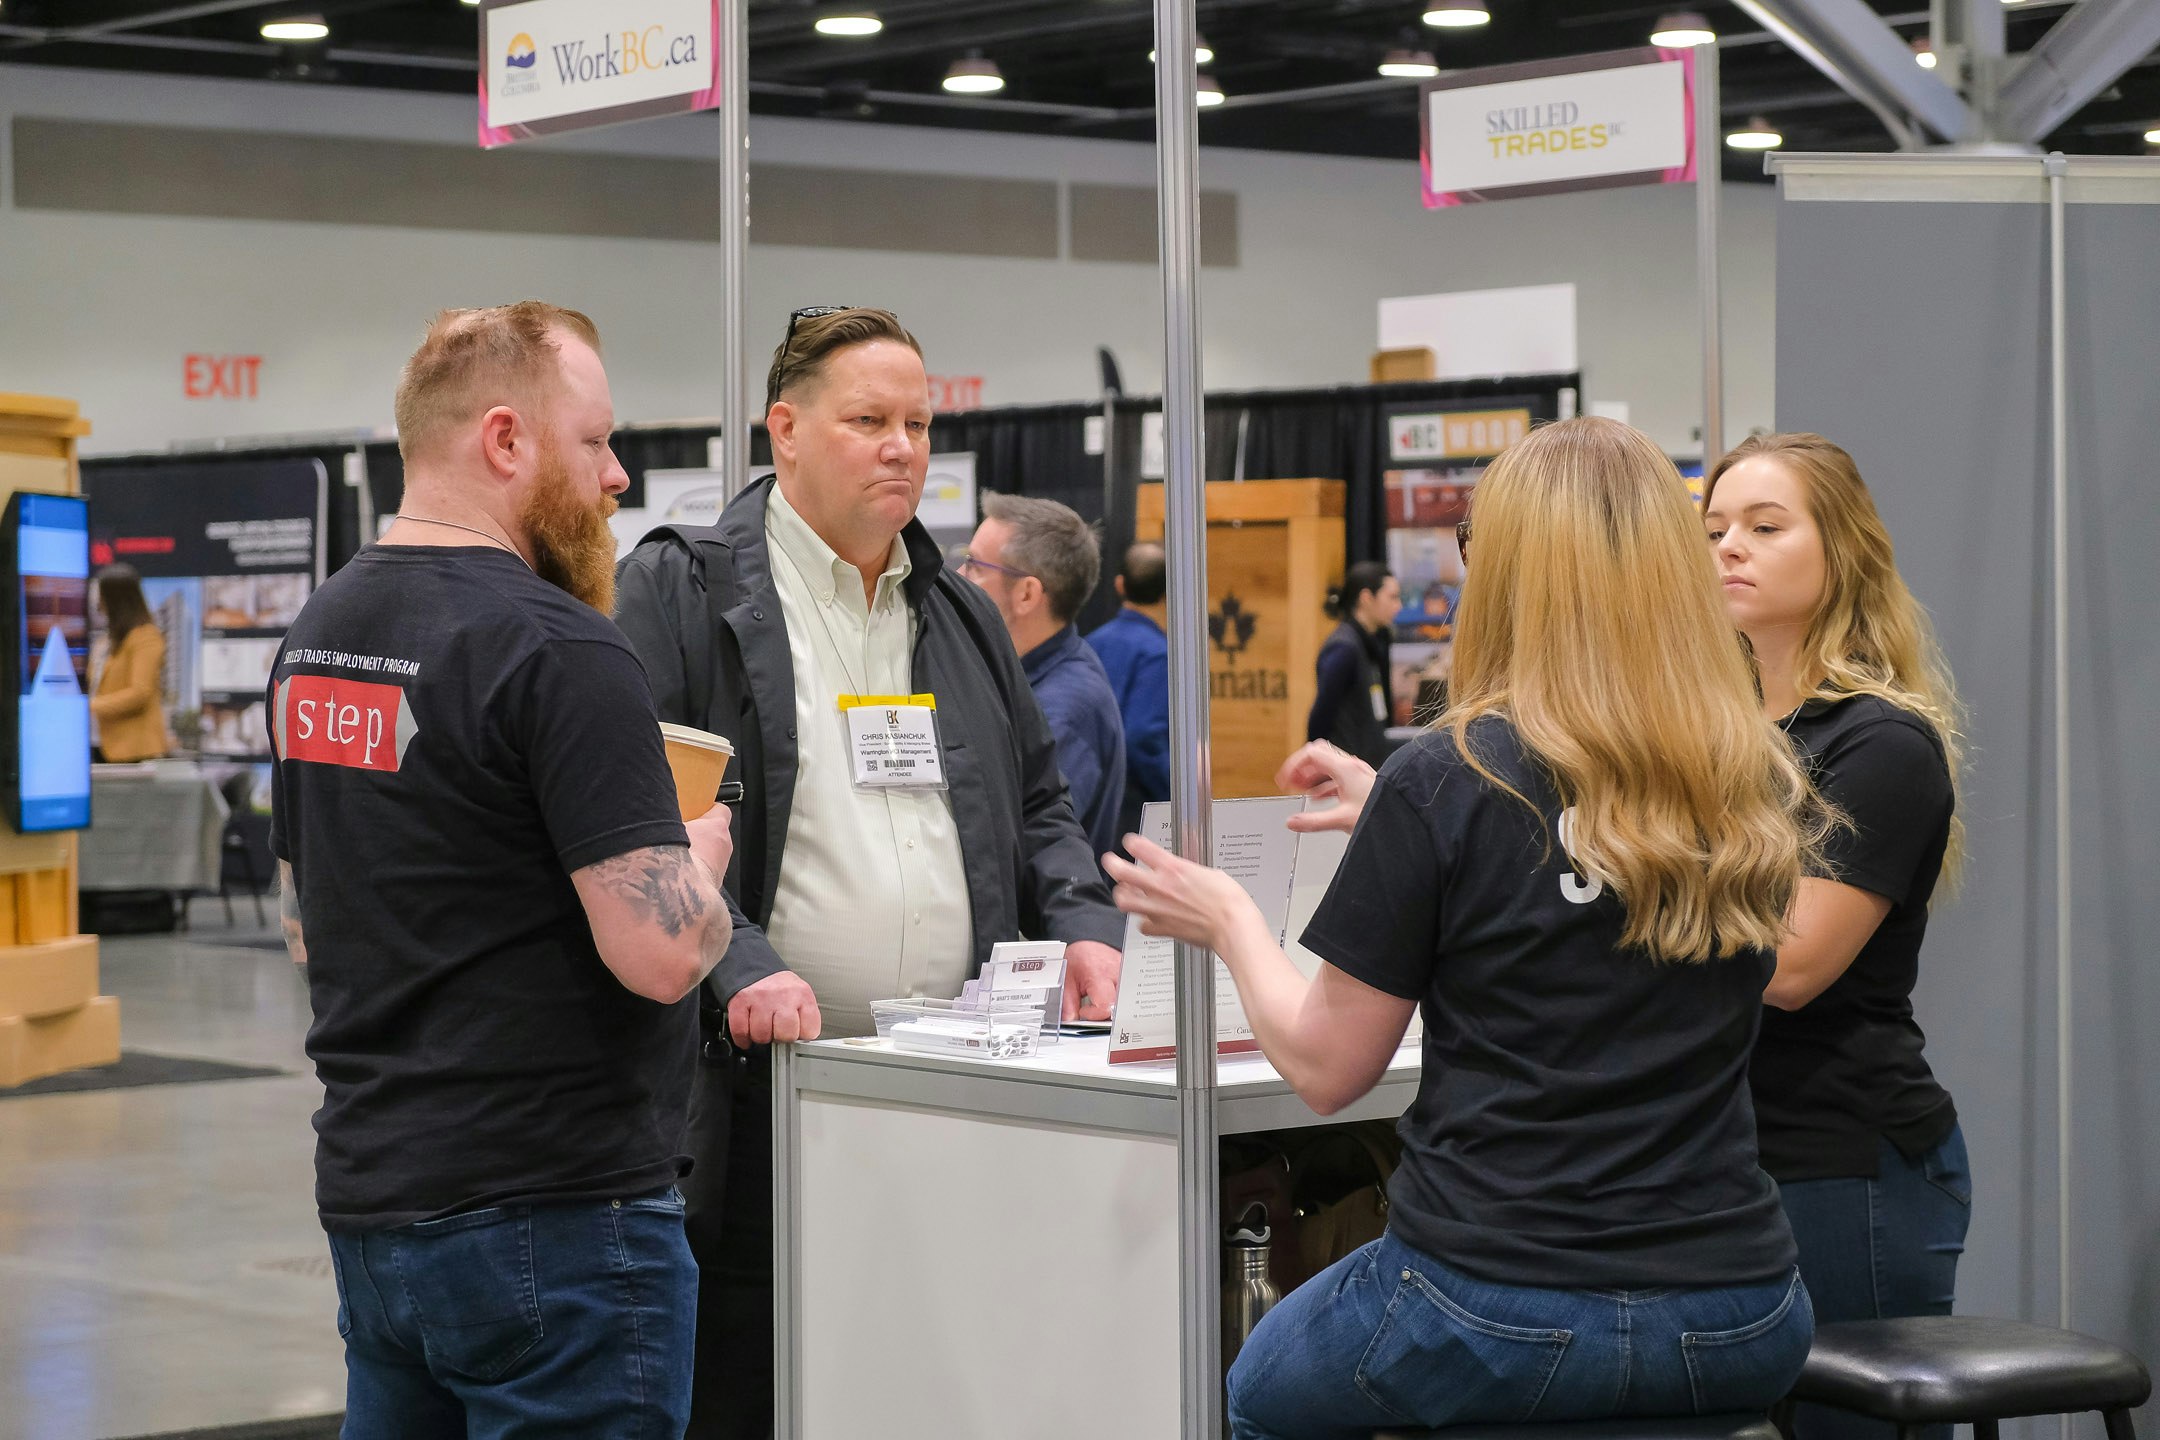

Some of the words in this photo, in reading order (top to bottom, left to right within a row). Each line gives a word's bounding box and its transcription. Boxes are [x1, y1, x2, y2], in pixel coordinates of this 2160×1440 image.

[552, 24, 697, 86] WorkBC.ca
[1486, 101, 1579, 134] SKILLED
[1488, 124, 1608, 158] TRADES
[183, 354, 262, 400] EXIT
[303, 649, 331, 664] TRADES
[332, 651, 382, 671] EMPLOYMENT
[297, 690, 382, 764] step
[1020, 962, 1040, 971] step
